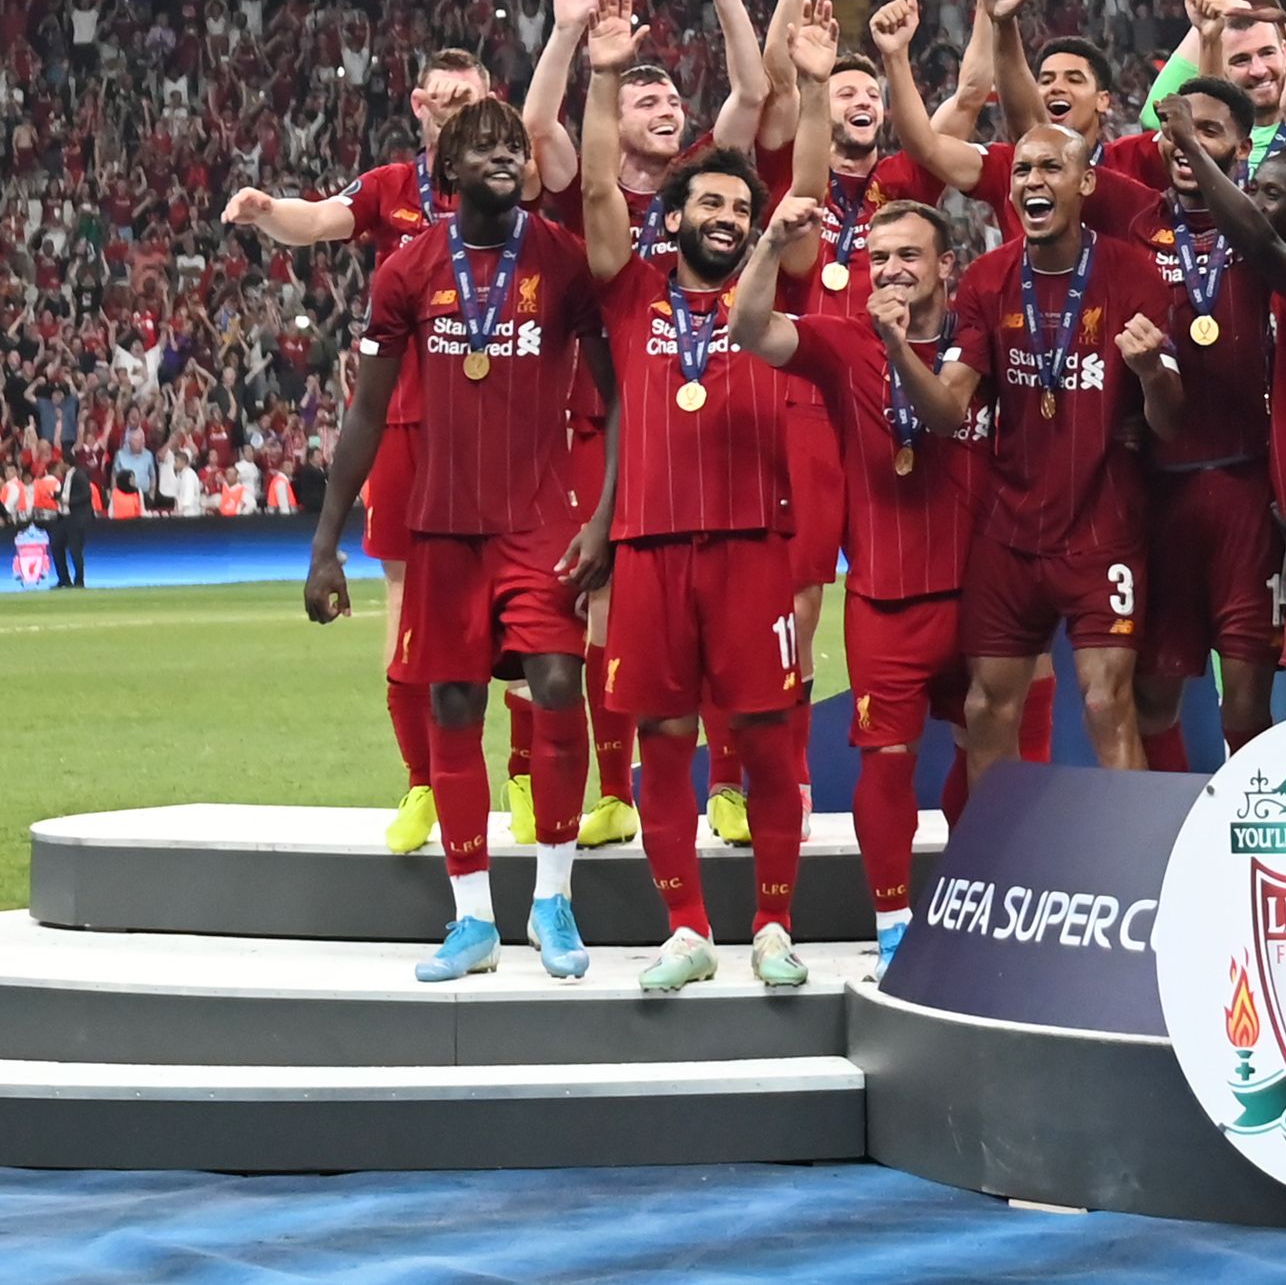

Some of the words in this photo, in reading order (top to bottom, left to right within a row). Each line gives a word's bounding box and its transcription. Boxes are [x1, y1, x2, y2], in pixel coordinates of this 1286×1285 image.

[517, 303, 538, 314] LFC
[1107, 563, 1134, 616] 3
[773, 612, 796, 670] 11
[929, 876, 995, 935] UEFA
[993, 885, 1120, 949] SUPER
